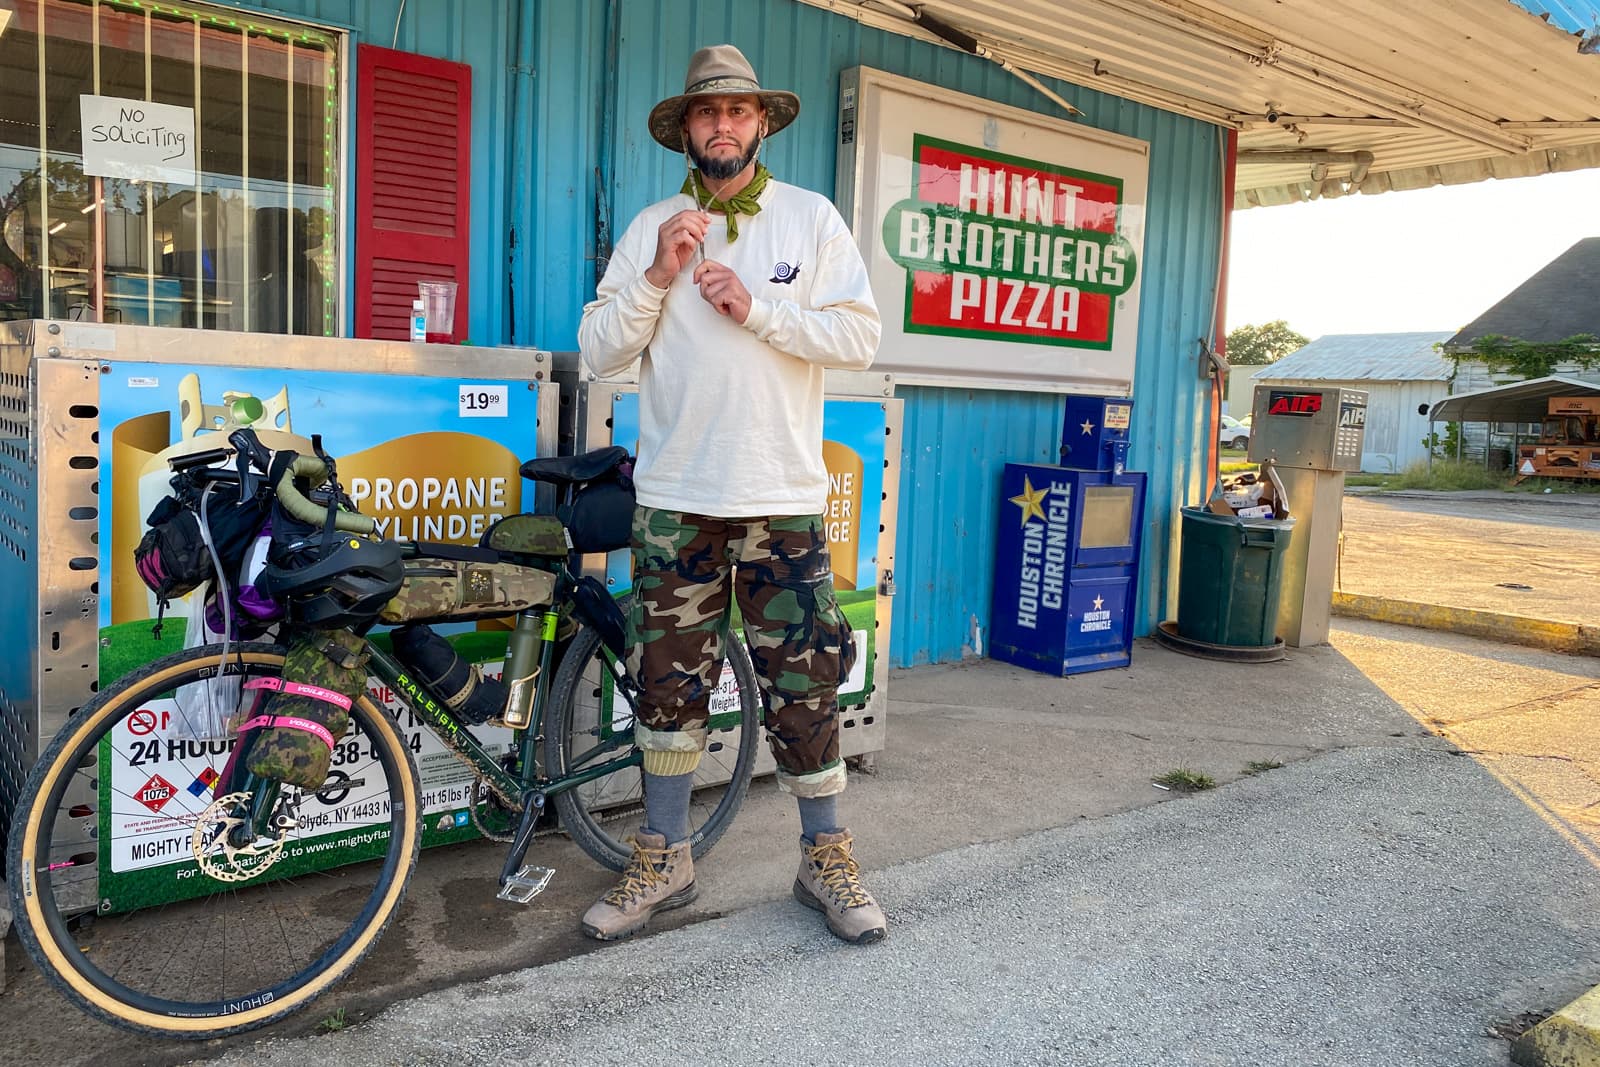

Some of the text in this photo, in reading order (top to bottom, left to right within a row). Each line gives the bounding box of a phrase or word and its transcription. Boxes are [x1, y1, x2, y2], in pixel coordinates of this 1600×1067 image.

[119, 107, 145, 123] NO
[958, 162, 1085, 231] HUNT
[899, 209, 1126, 287] BROTHERS
[949, 271, 1081, 333] PIZZA
[1268, 394, 1323, 415] AIR
[1339, 406, 1365, 427] AIR
[351, 477, 507, 511] PROPANE
[1042, 480, 1072, 610] CHRONICLE
[1017, 521, 1045, 629] HOUSTON
[1080, 620, 1112, 633] CHRONICLE
[1083, 610, 1110, 622] HOUSTON
[397, 674, 458, 734] RALEIGH
[711, 696, 735, 711] Weight
[129, 739, 161, 767] 24
[143, 786, 169, 801] 1075
[131, 837, 182, 861] MIGHTY
[335, 807, 349, 822] NY
[351, 802, 380, 819] 14433
[438, 788, 447, 804] 15
[448, 787, 462, 803] lbs
[176, 867, 198, 880] For
[291, 847, 303, 858] to
[222, 996, 262, 1015] HUNT
